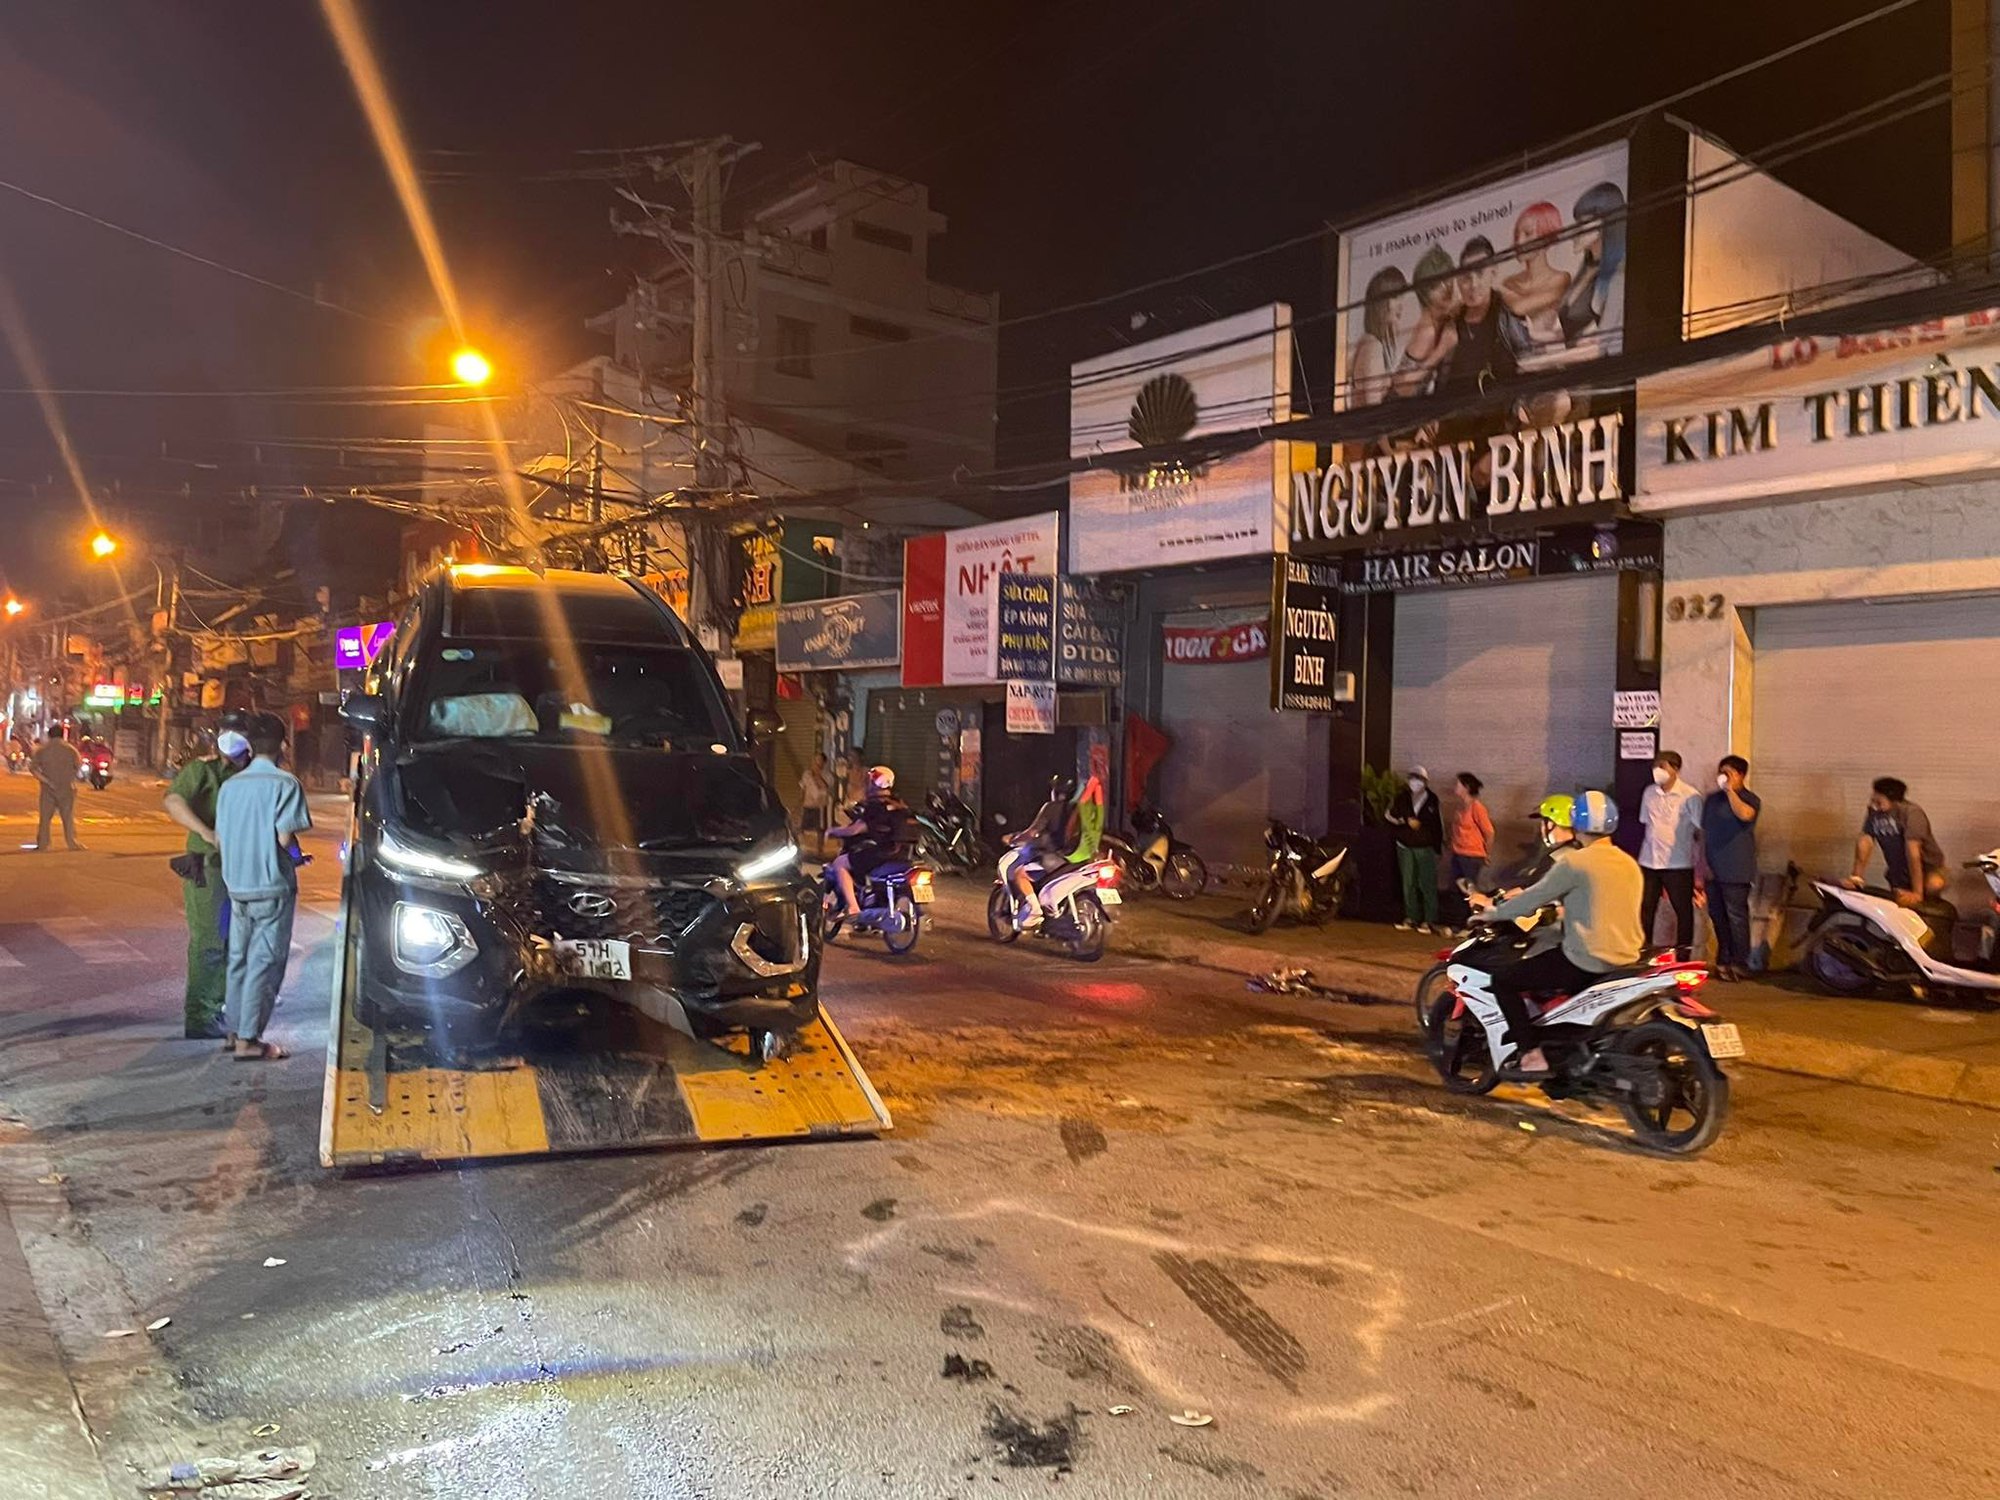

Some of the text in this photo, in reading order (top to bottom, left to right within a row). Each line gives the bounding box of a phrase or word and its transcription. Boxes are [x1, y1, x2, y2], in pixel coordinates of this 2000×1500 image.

[1425, 226, 1449, 245] you
[1469, 200, 1513, 227] shine!
[1662, 402, 1777, 464] KIM
[1288, 560, 1310, 586] HAIR
[1364, 555, 1431, 582] HAIR
[1438, 542, 1537, 575] SALON
[1666, 593, 1726, 621] 932
[1294, 645, 1325, 687] BÌNH
